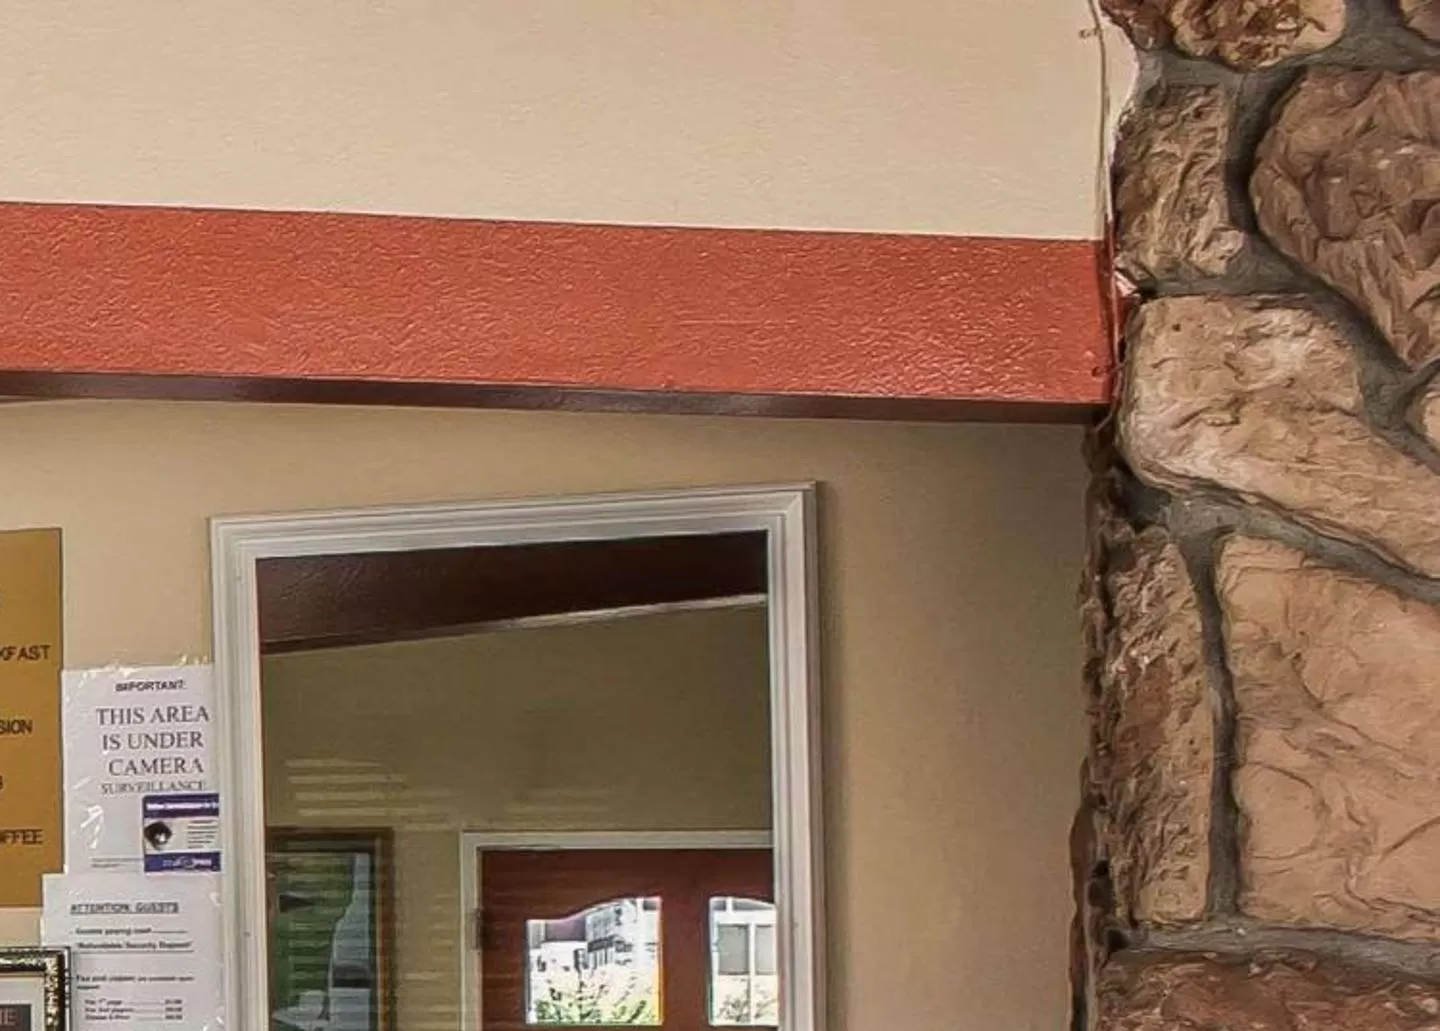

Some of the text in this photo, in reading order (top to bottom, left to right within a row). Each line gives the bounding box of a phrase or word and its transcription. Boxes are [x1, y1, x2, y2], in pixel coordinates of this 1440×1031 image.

[96, 705, 210, 725] THIS AREA
[103, 731, 204, 751] IS UNDER
[108, 757, 204, 776] CAMERA
[101, 781, 205, 794] SURVEILLANCE
[70, 902, 130, 914] ATTENTION
